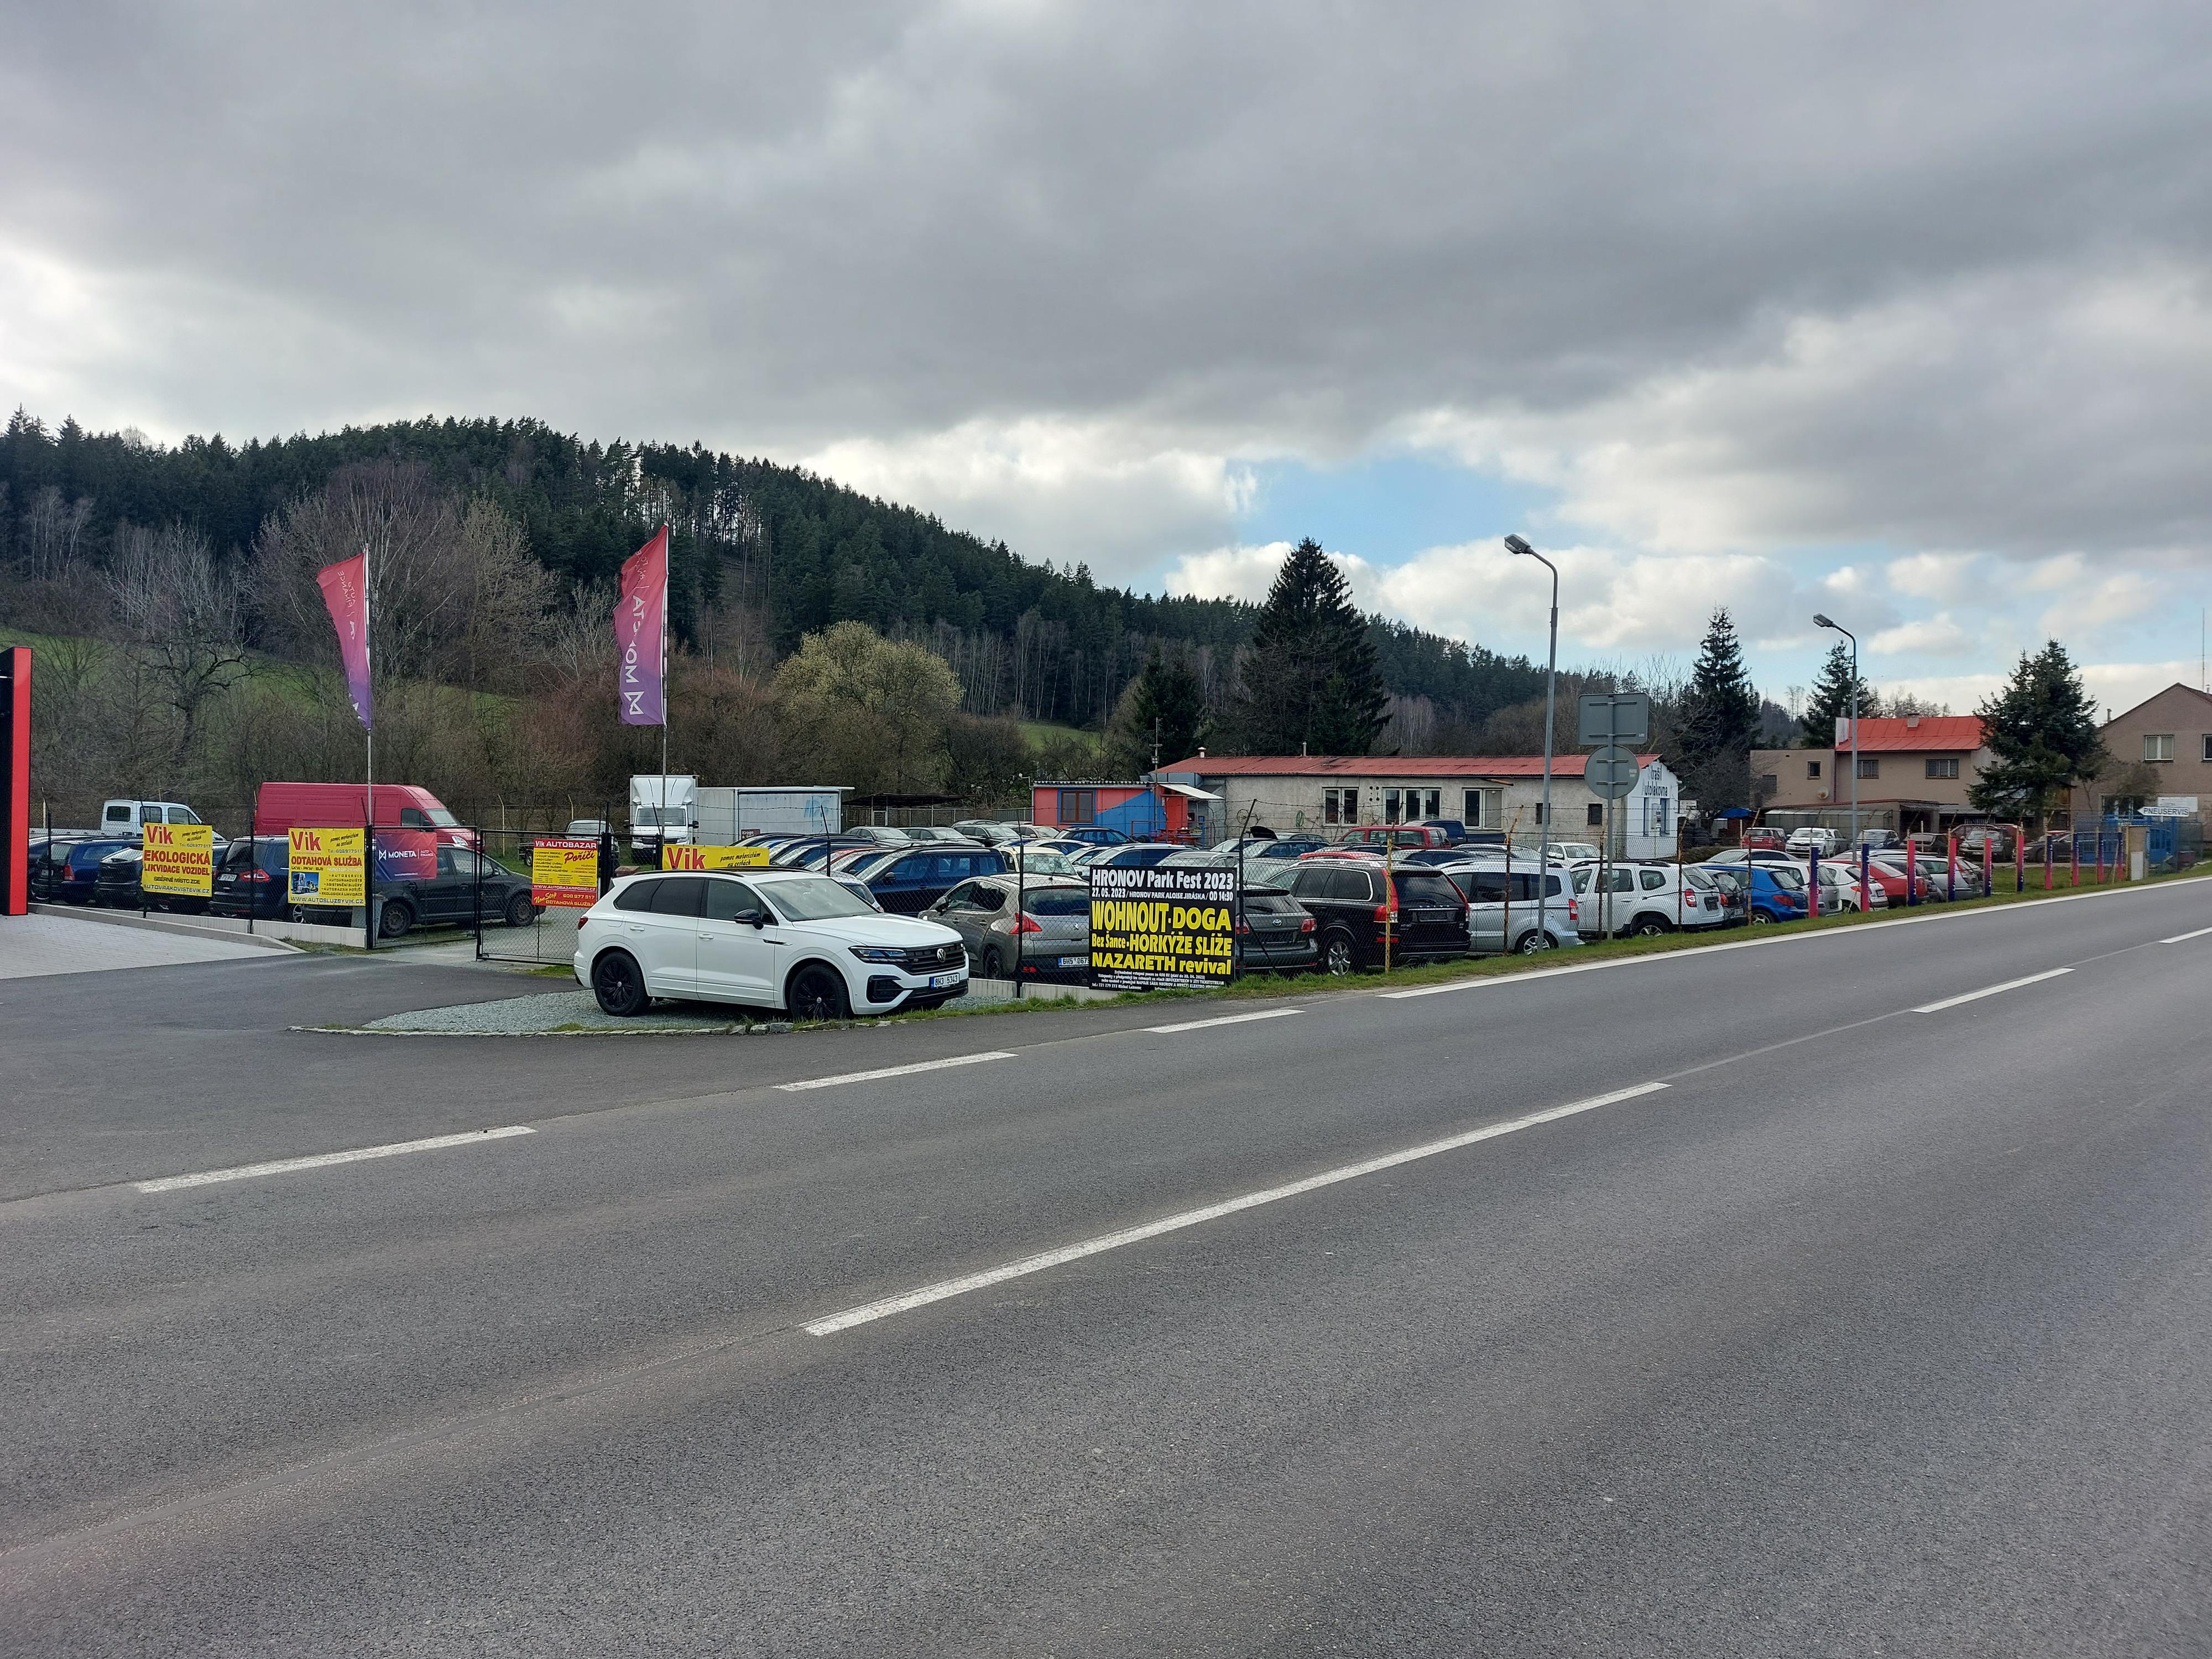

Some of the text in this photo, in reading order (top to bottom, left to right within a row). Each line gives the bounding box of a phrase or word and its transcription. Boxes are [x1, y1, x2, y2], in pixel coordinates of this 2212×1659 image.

[146, 825, 174, 844] Vik
[291, 831, 321, 851] Vik
[144, 850, 211, 865] EKOLOGICKÁ
[291, 855, 362, 866] ODTAHOVÁ SLUŽBA
[564, 850, 595, 864] Poříčí
[666, 847, 706, 869] Vik
[144, 863, 210, 875] LIKVIDACE VOZIDEL
[1092, 869, 1234, 890] HRONOV Park Fest 2023
[1092, 887, 1100, 898] 27.
[1111, 888, 1125, 898] 2023
[1209, 891, 1217, 901] OD
[1092, 900, 1232, 933] WOHNOUT DOGA
[1092, 931, 1232, 957] Bez Šance HORKÝŽE SLÍŽE
[1092, 952, 1232, 975] NAZARETH revival
[947, 975, 958, 983] 5343
